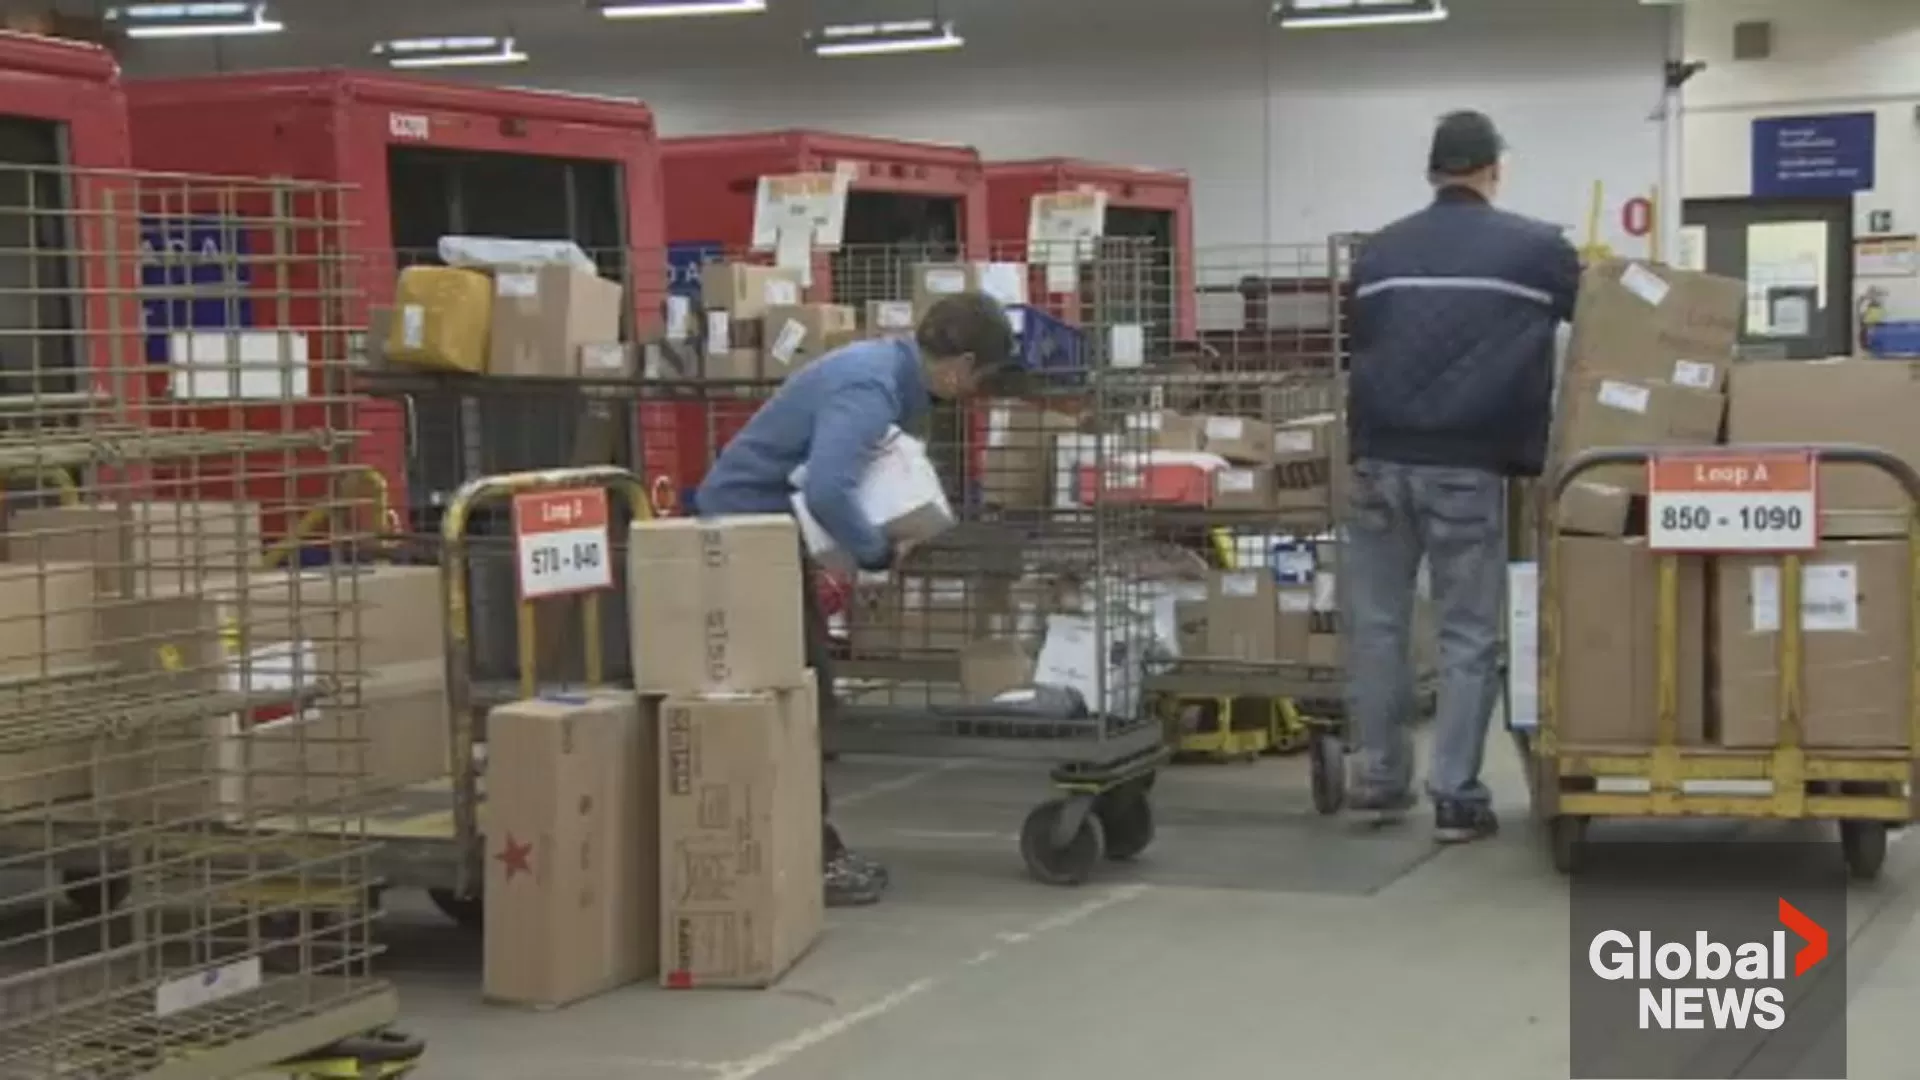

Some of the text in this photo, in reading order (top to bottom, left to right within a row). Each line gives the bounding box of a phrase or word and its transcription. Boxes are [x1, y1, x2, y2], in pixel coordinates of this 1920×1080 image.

[1694, 464, 1768, 486] Loop A
[1661, 506, 1711, 530] 850
[1739, 505, 1802, 530] 1090
[531, 546, 561, 576] 570
